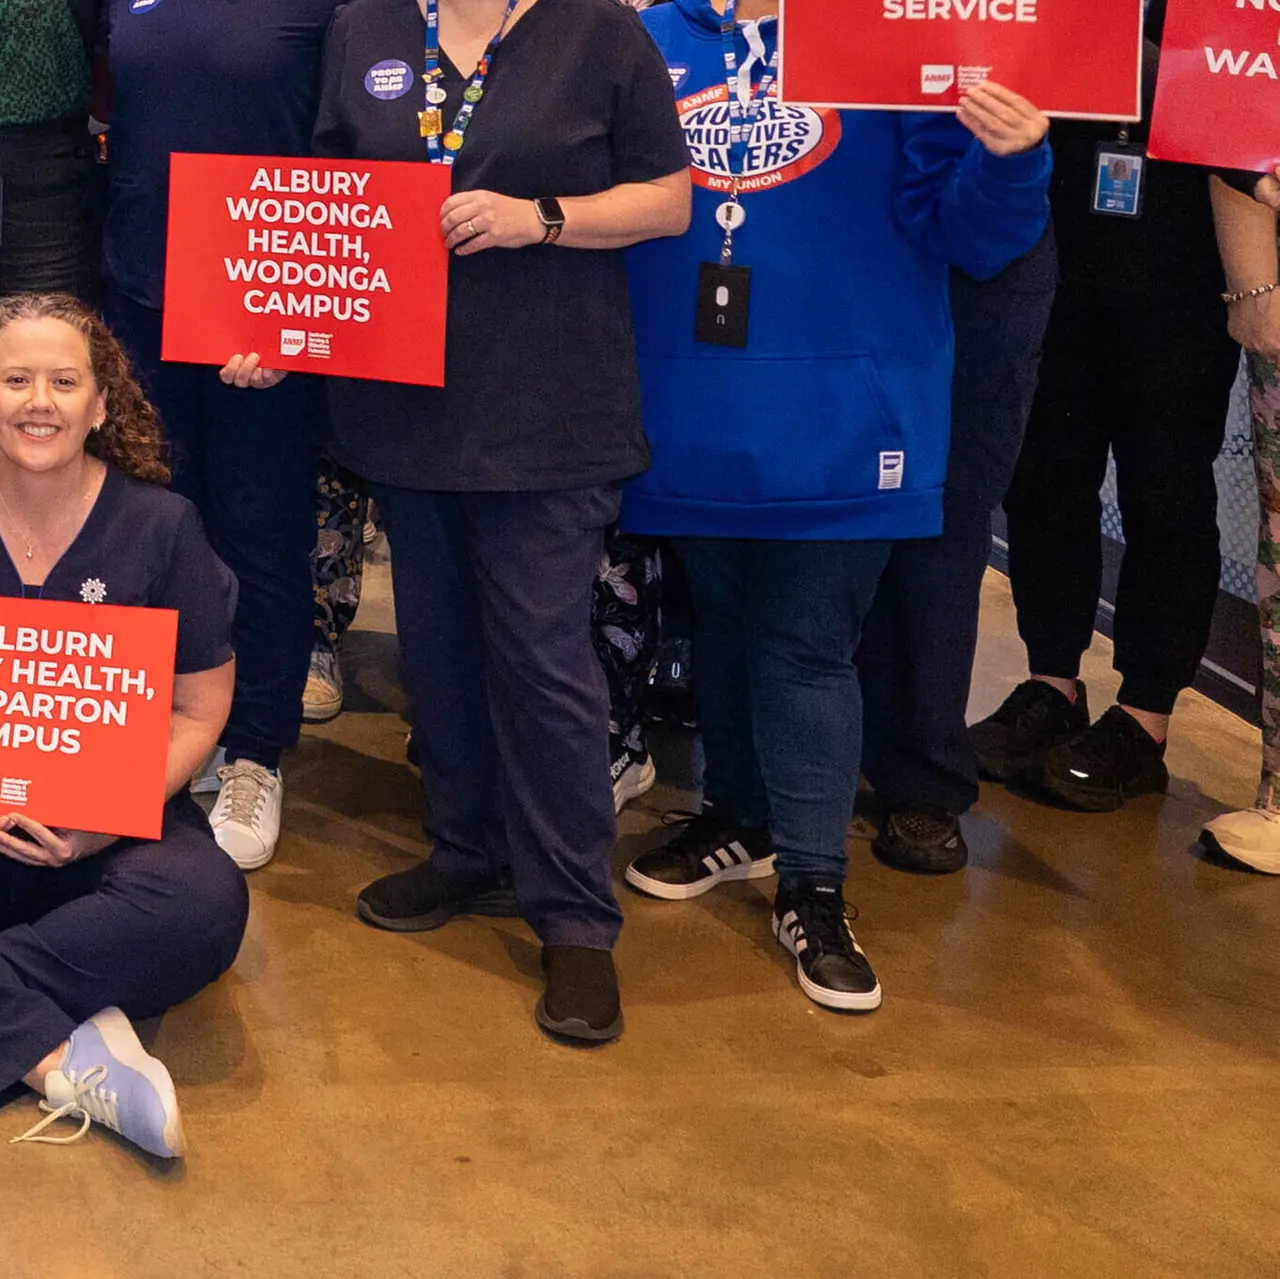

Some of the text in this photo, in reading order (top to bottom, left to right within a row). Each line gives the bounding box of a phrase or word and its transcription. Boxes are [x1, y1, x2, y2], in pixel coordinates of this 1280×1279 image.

[371, 68, 406, 77] PROUD
[374, 84, 403, 92] ANMF
[682, 89, 724, 110] ANMF
[684, 121, 810, 145] MIDIVES
[690, 138, 804, 172] CAERS
[249, 167, 371, 196] ALBURY
[707, 172, 782, 190] MY UNION
[225, 196, 393, 230] WODONGA
[247, 228, 370, 264] HEALTH,
[223, 257, 391, 293] WODONGA
[243, 289, 371, 323] CAMPUS
[11, 658, 155, 701] HEALTH,
